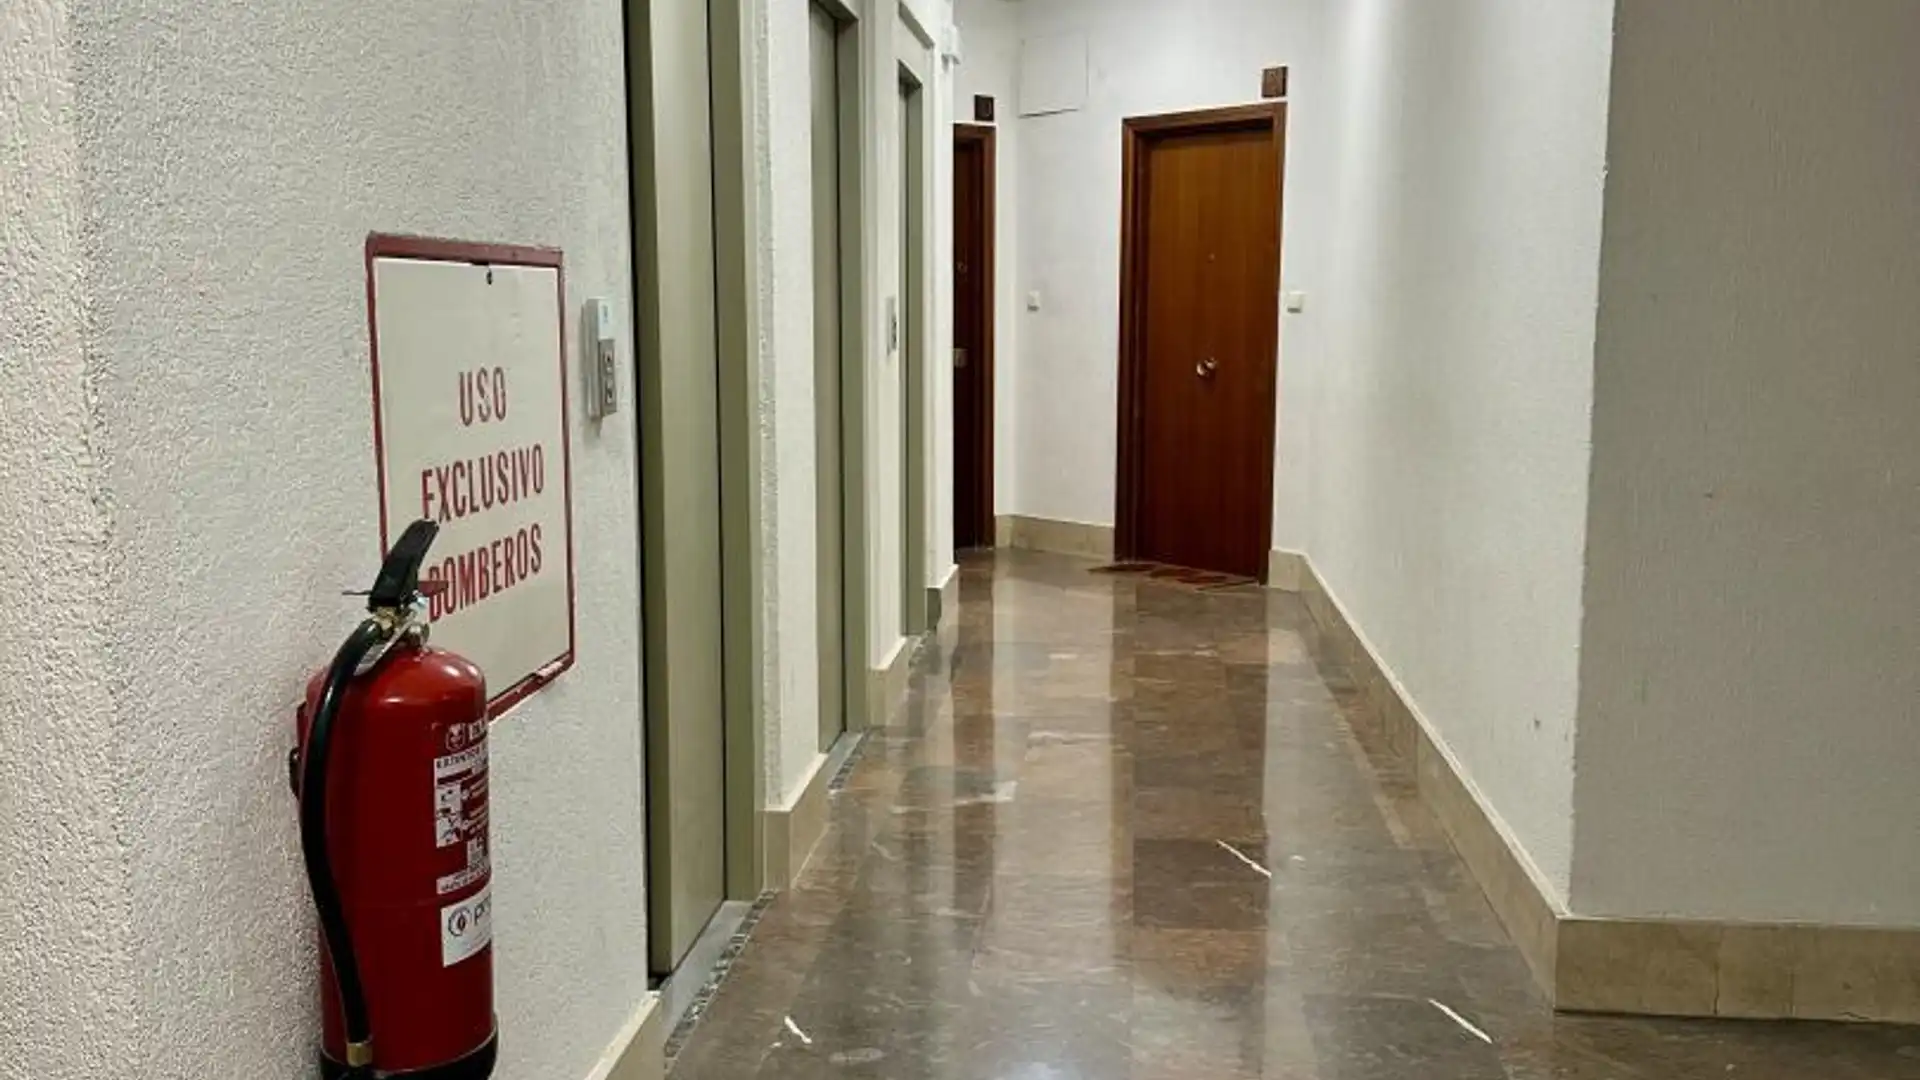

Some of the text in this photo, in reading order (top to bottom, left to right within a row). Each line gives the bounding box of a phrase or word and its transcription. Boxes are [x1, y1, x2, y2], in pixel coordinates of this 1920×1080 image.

[459, 366, 507, 427] USO
[421, 443, 545, 524] EXCLUSIVO
[427, 522, 543, 623] BOMBEROS
